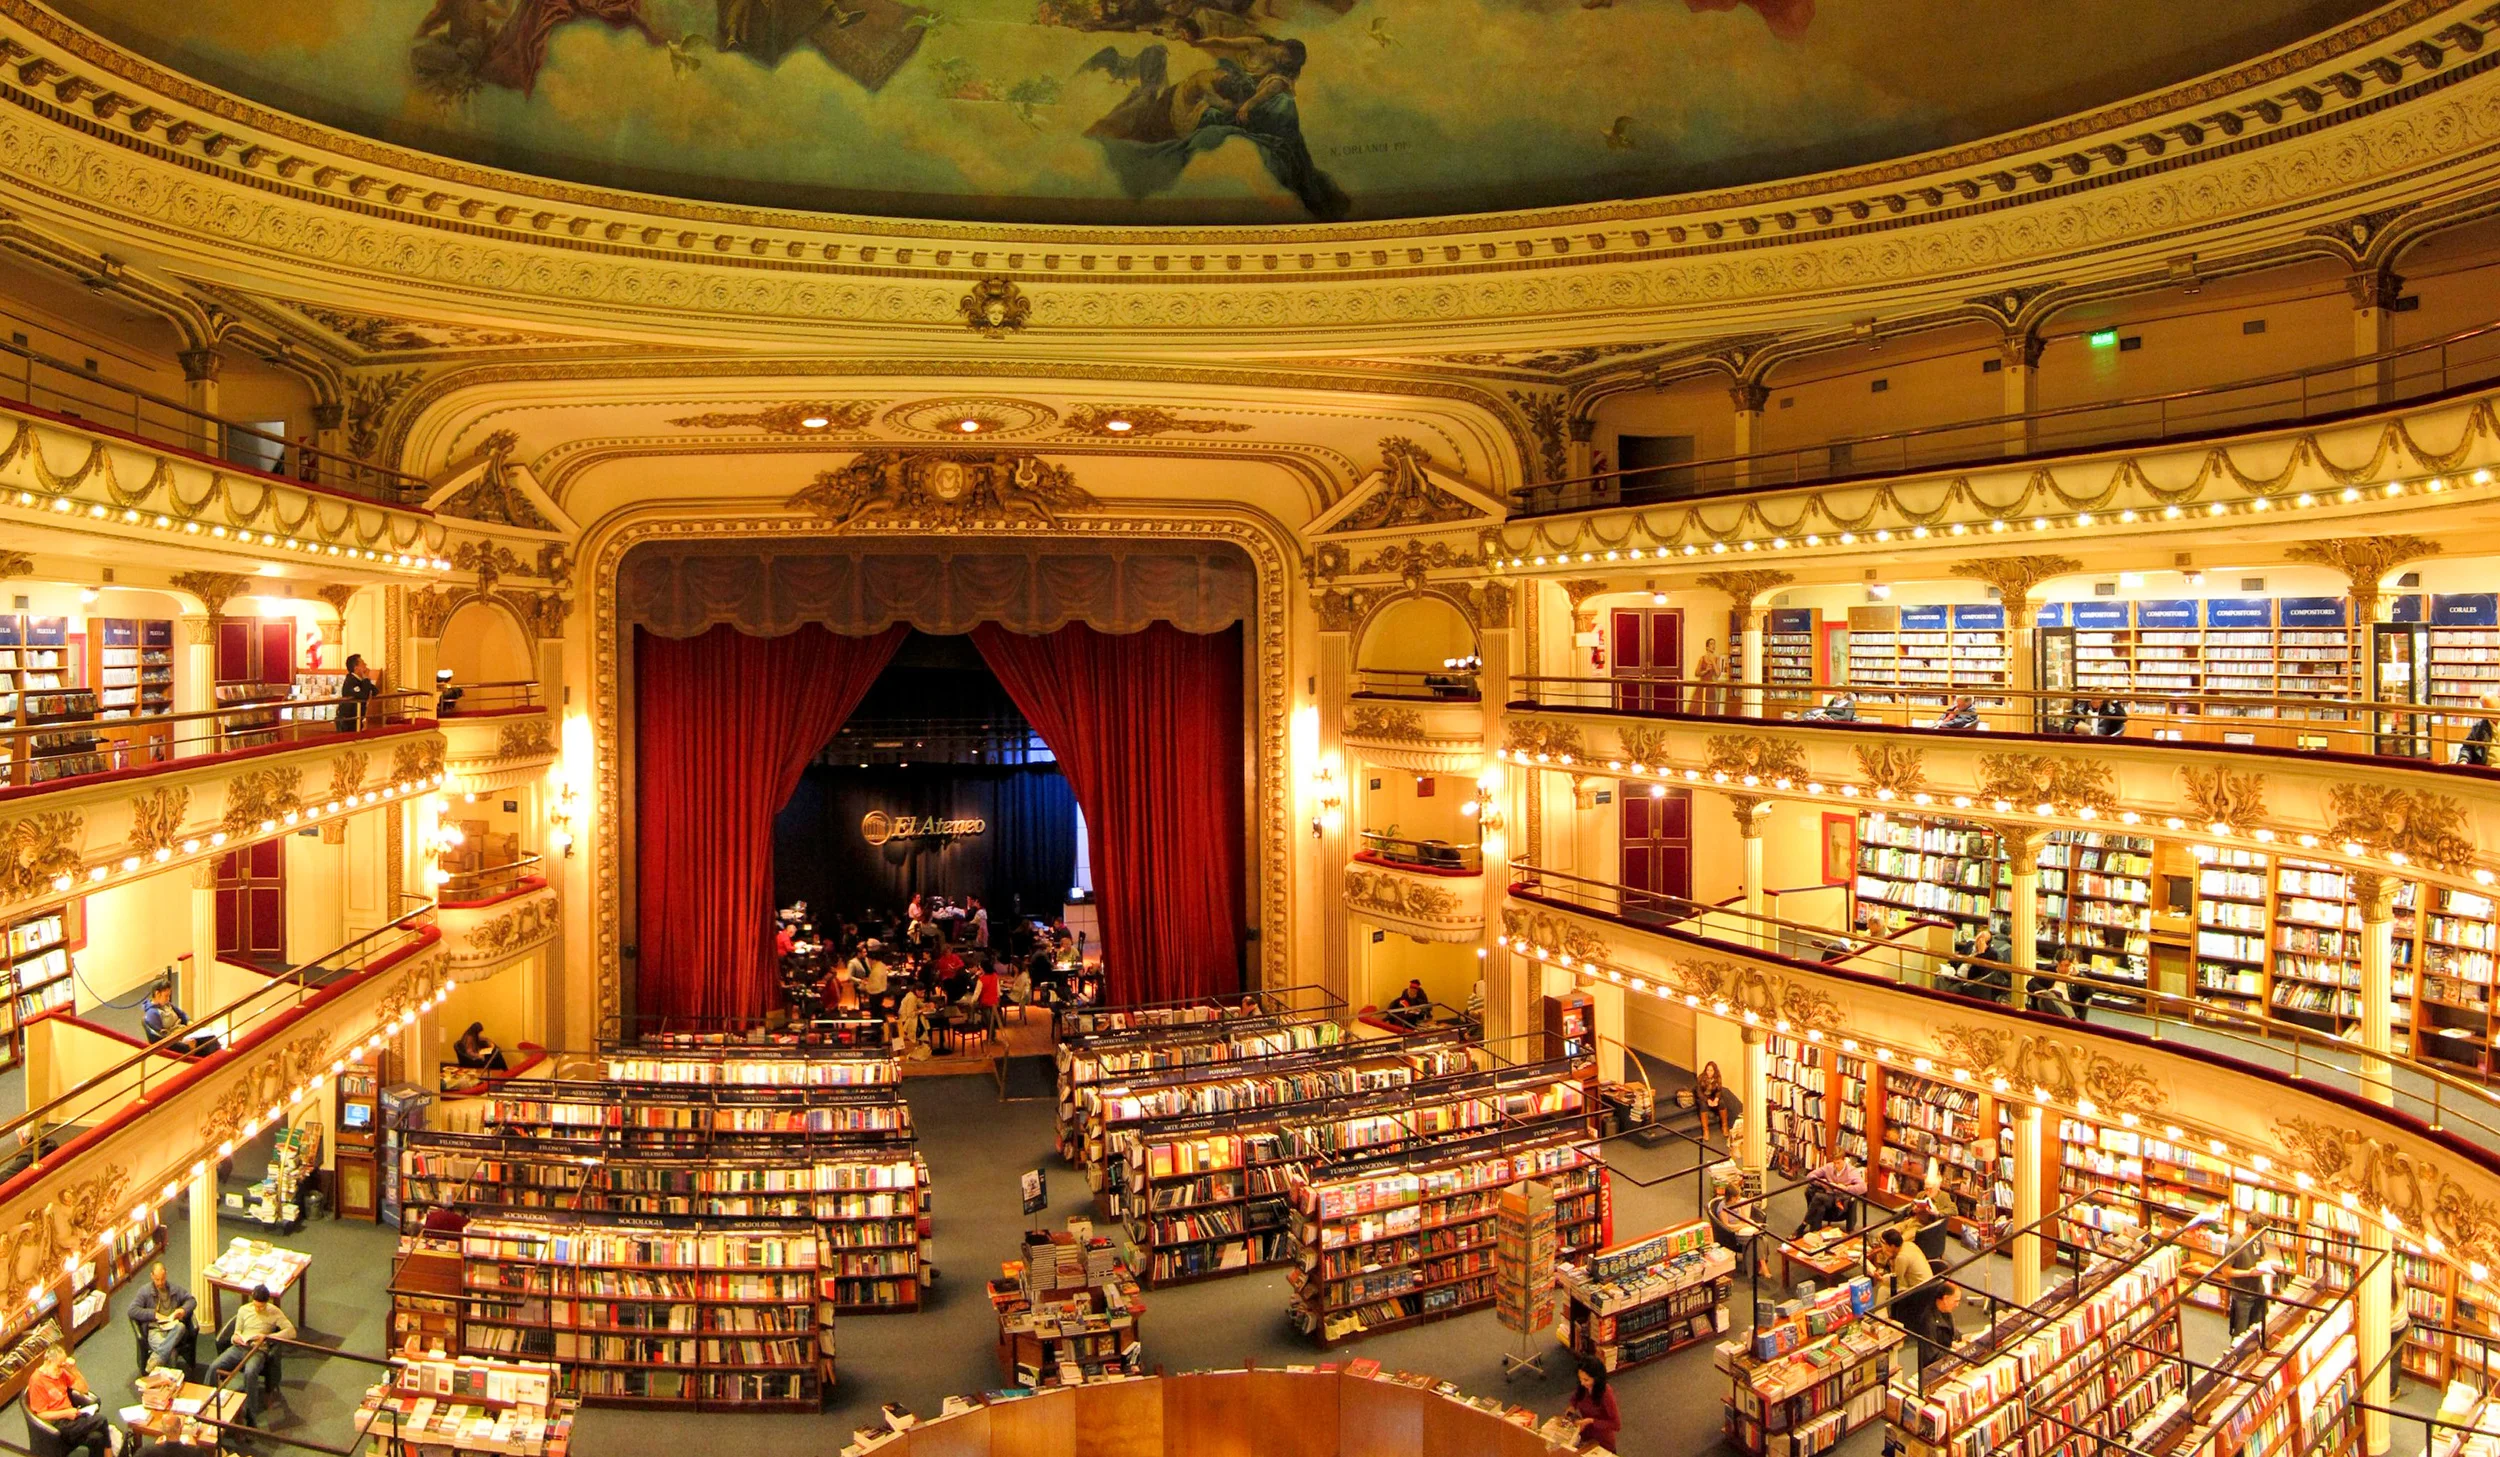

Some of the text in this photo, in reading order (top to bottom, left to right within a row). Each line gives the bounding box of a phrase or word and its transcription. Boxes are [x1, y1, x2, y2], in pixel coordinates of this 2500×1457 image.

[2080, 611, 2120, 619] COMPOSITORES
[2146, 610, 2189, 618] COMPOSITORES
[891, 815, 986, 837] El Ateneo
[1231, 1022, 1269, 1031] ARQUITECTURA
[1166, 1029, 1204, 1038] ARQUITECTURA
[1090, 1037, 1129, 1046] ARQUITECTURA
[1208, 1066, 1242, 1075] FOTOGRAFIA
[1125, 1076, 1160, 1085] FOTOGRAFIA
[1274, 1110, 1289, 1118] ARTE
[1163, 1120, 1216, 1131] ARTE ARGENTINO
[1533, 1126, 1559, 1137] TURISMO
[440, 1139, 471, 1148] FILOSOFIA
[539, 1144, 572, 1152] FILOSOFIA
[845, 1148, 878, 1156] FILOSOFIA
[1443, 1145, 1470, 1156] TURISMO
[1330, 1160, 1392, 1175] TURISMO NACIONAL
[503, 1212, 548, 1221] SOCIOLOGIA
[618, 1218, 664, 1227] SOCIOLOGIA
